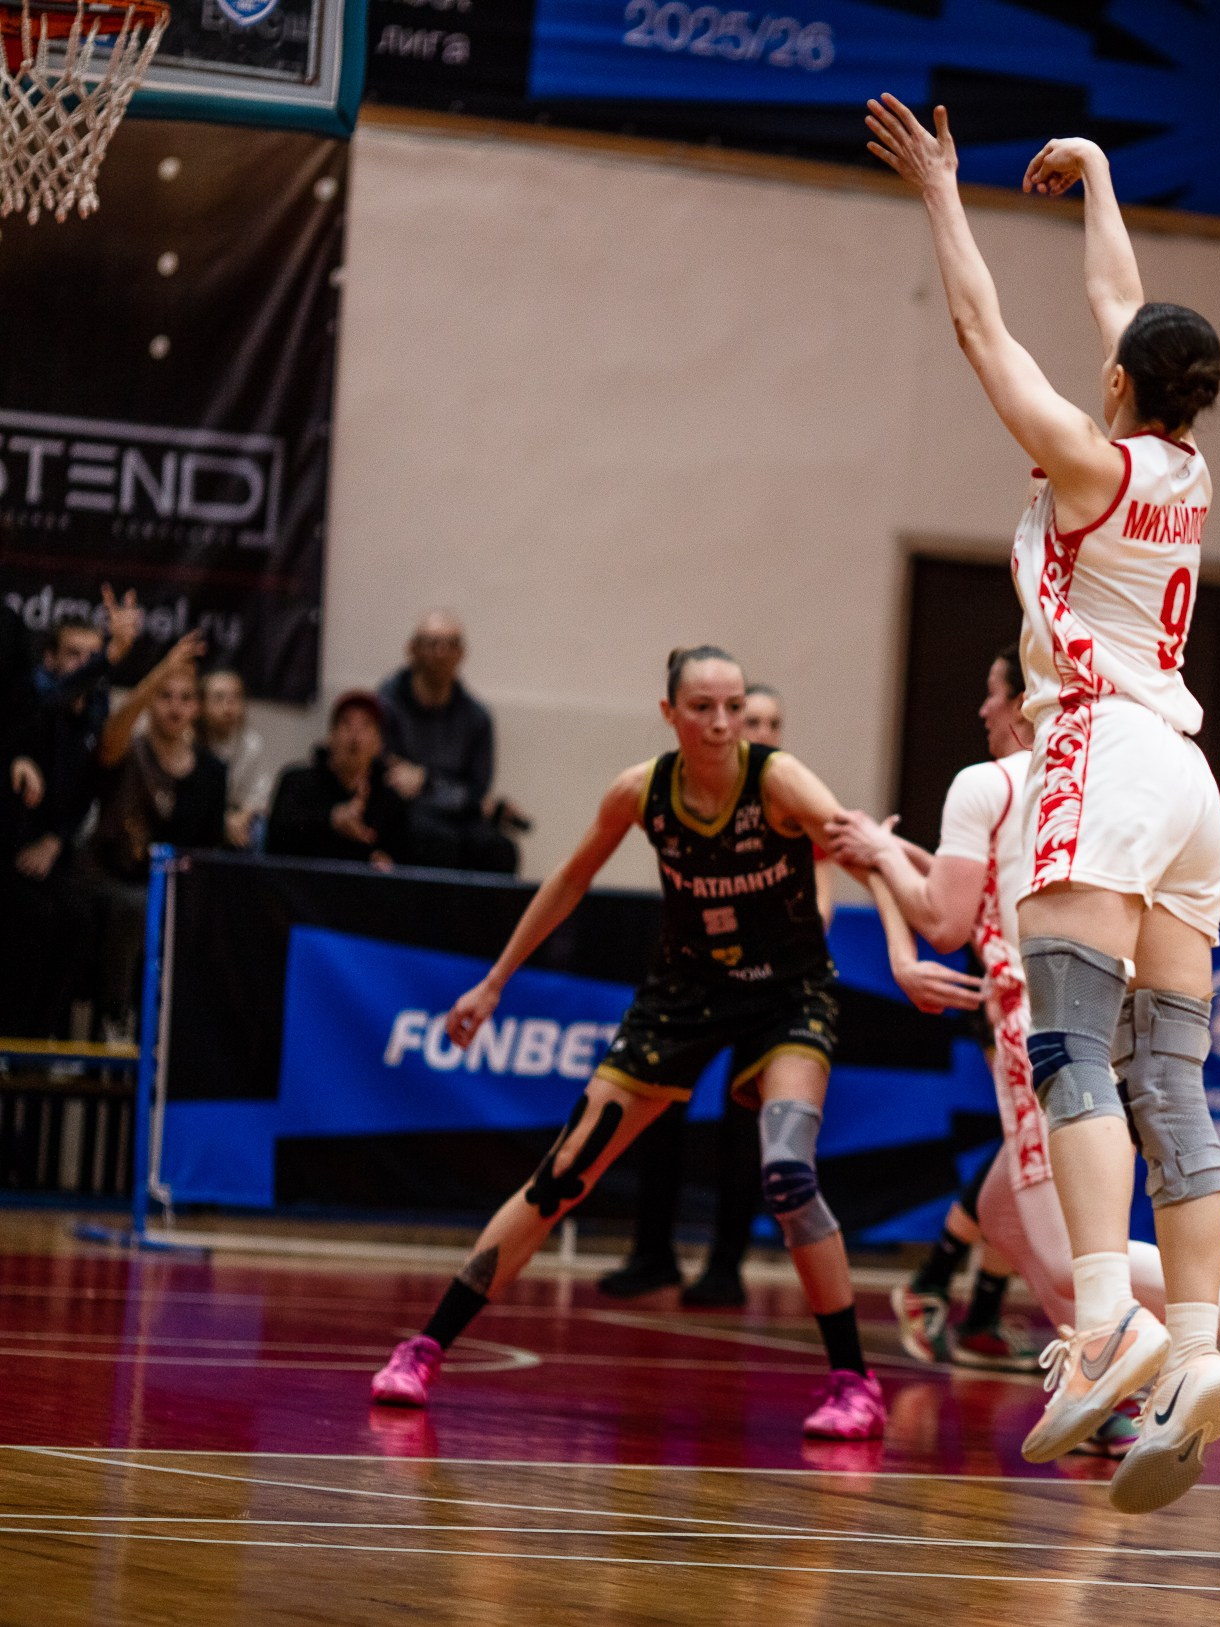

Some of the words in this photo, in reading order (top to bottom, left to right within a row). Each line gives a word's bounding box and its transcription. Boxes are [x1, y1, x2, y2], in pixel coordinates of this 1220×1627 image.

[376, 24, 471, 65] лига
[623, 0, 836, 71] 2025/26
[0, 432, 265, 523] TEND
[1157, 567, 1192, 670] 9
